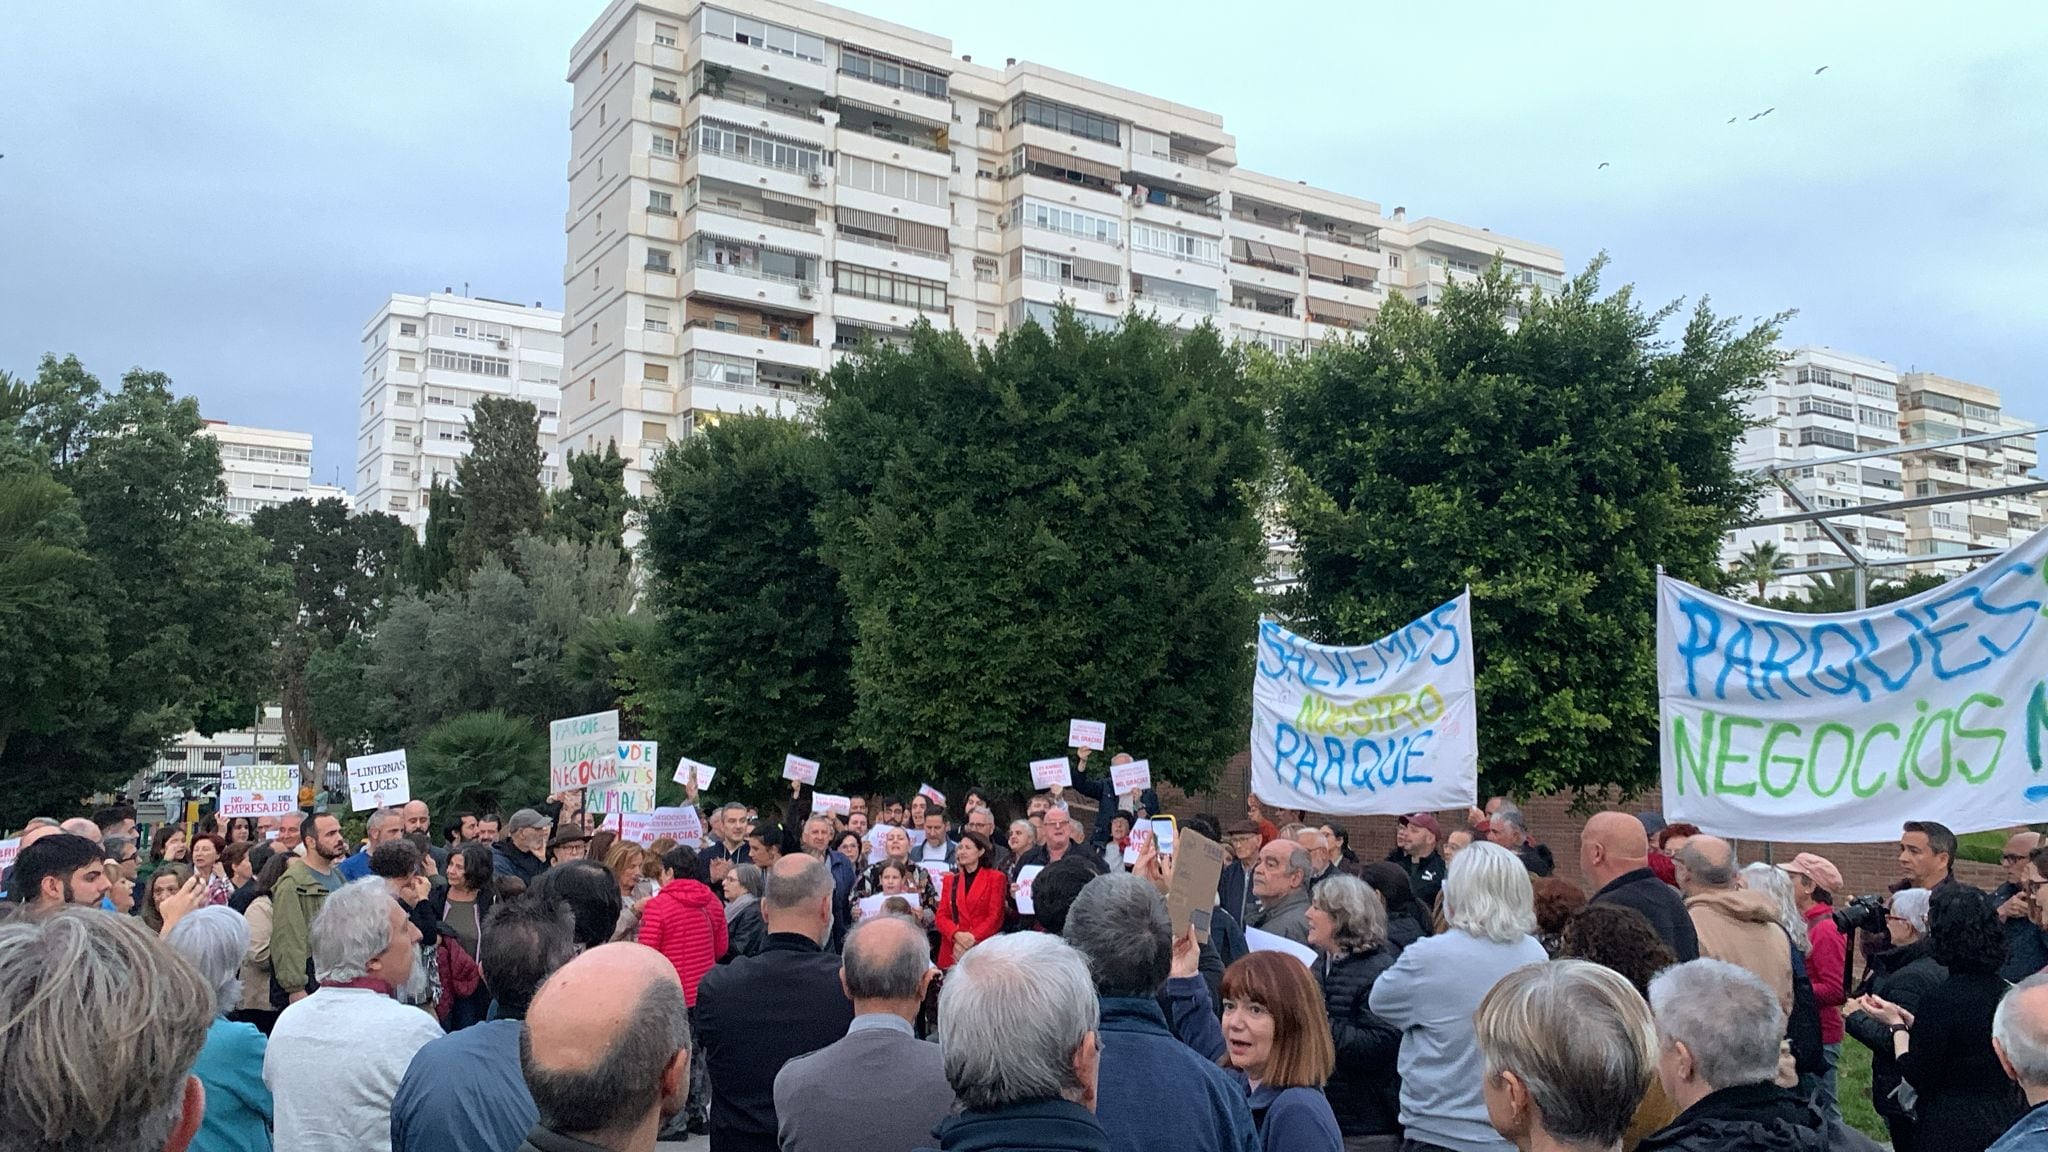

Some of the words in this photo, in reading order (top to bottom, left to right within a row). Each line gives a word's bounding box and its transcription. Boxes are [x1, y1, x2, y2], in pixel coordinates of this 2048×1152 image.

[1678, 562, 2041, 703] PARQUES
[1260, 602, 1460, 688] SALVEMOS
[1275, 721, 1434, 797] PARQUE
[222, 770, 235, 780] EL
[236, 767, 289, 780] PARQUE
[552, 759, 617, 788] NEGOCIAR
[222, 782, 238, 790] DEL
[239, 779, 293, 791] BARRIO
[360, 777, 399, 794] LUCES
[230, 795, 243, 804] NO
[224, 802, 291, 815] EMPRESARIO
